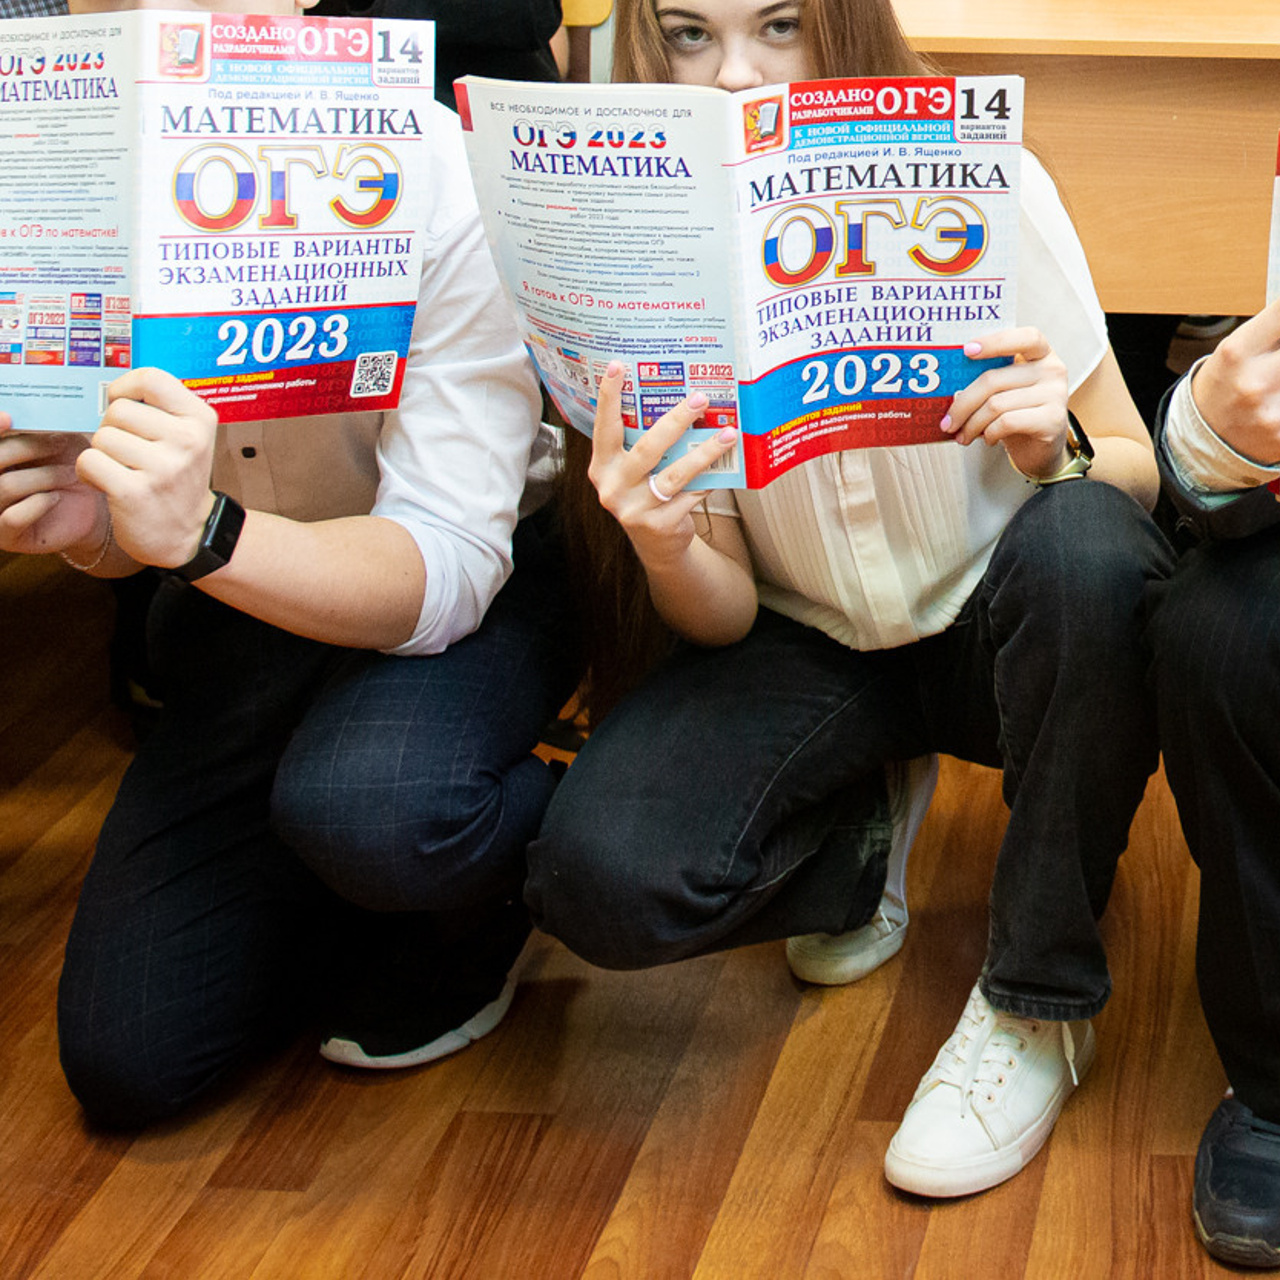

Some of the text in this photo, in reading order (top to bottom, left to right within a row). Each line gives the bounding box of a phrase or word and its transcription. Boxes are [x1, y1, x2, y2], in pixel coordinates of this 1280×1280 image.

[212, 24, 296, 42] СОЗДАНО
[297, 26, 369, 56] ОГЭ
[377, 30, 423, 63] 14
[490, 102, 692, 118] ВСЕ НЕОБХОДИМОЕ И ДОСТАТОЧНОЕ ДЛЯ
[790, 88, 874, 107] СОЗДАНО
[875, 87, 952, 115] ОГЭ
[960, 88, 1011, 121] 14
[161, 106, 423, 135] МАТЕМАТИКА
[791, 105, 874, 120] РАЗРАБОТЧИКАМИ
[794, 123, 951, 138] К НОВОЙ ОФИЦИАЛЬНОЙ
[510, 150, 692, 178] МАТЕМАТИКА
[788, 147, 962, 164] Под редакцией И. В. Ященко
[172, 142, 404, 234] ОГЭ
[750, 163, 1010, 207] МАТЕМАТИКА
[159, 237, 412, 261] ТИПОВЫЕ ВАРИАНТЫ
[761, 195, 990, 289] ОГЭ
[159, 259, 409, 285] ЭКЗАМЕНАЦИОННЫХ
[230, 280, 348, 309] ЗАДАНИЙ
[757, 286, 858, 325] ТИПОВЫЕ
[872, 284, 1002, 302] ВАРИАНТЫ
[216, 313, 350, 367] 2023
[758, 304, 1001, 347] ЭКЗАМЕНАЦИОННЫХ
[811, 323, 933, 350] ЗАДАНИЙ
[801, 353, 941, 405] 2023
